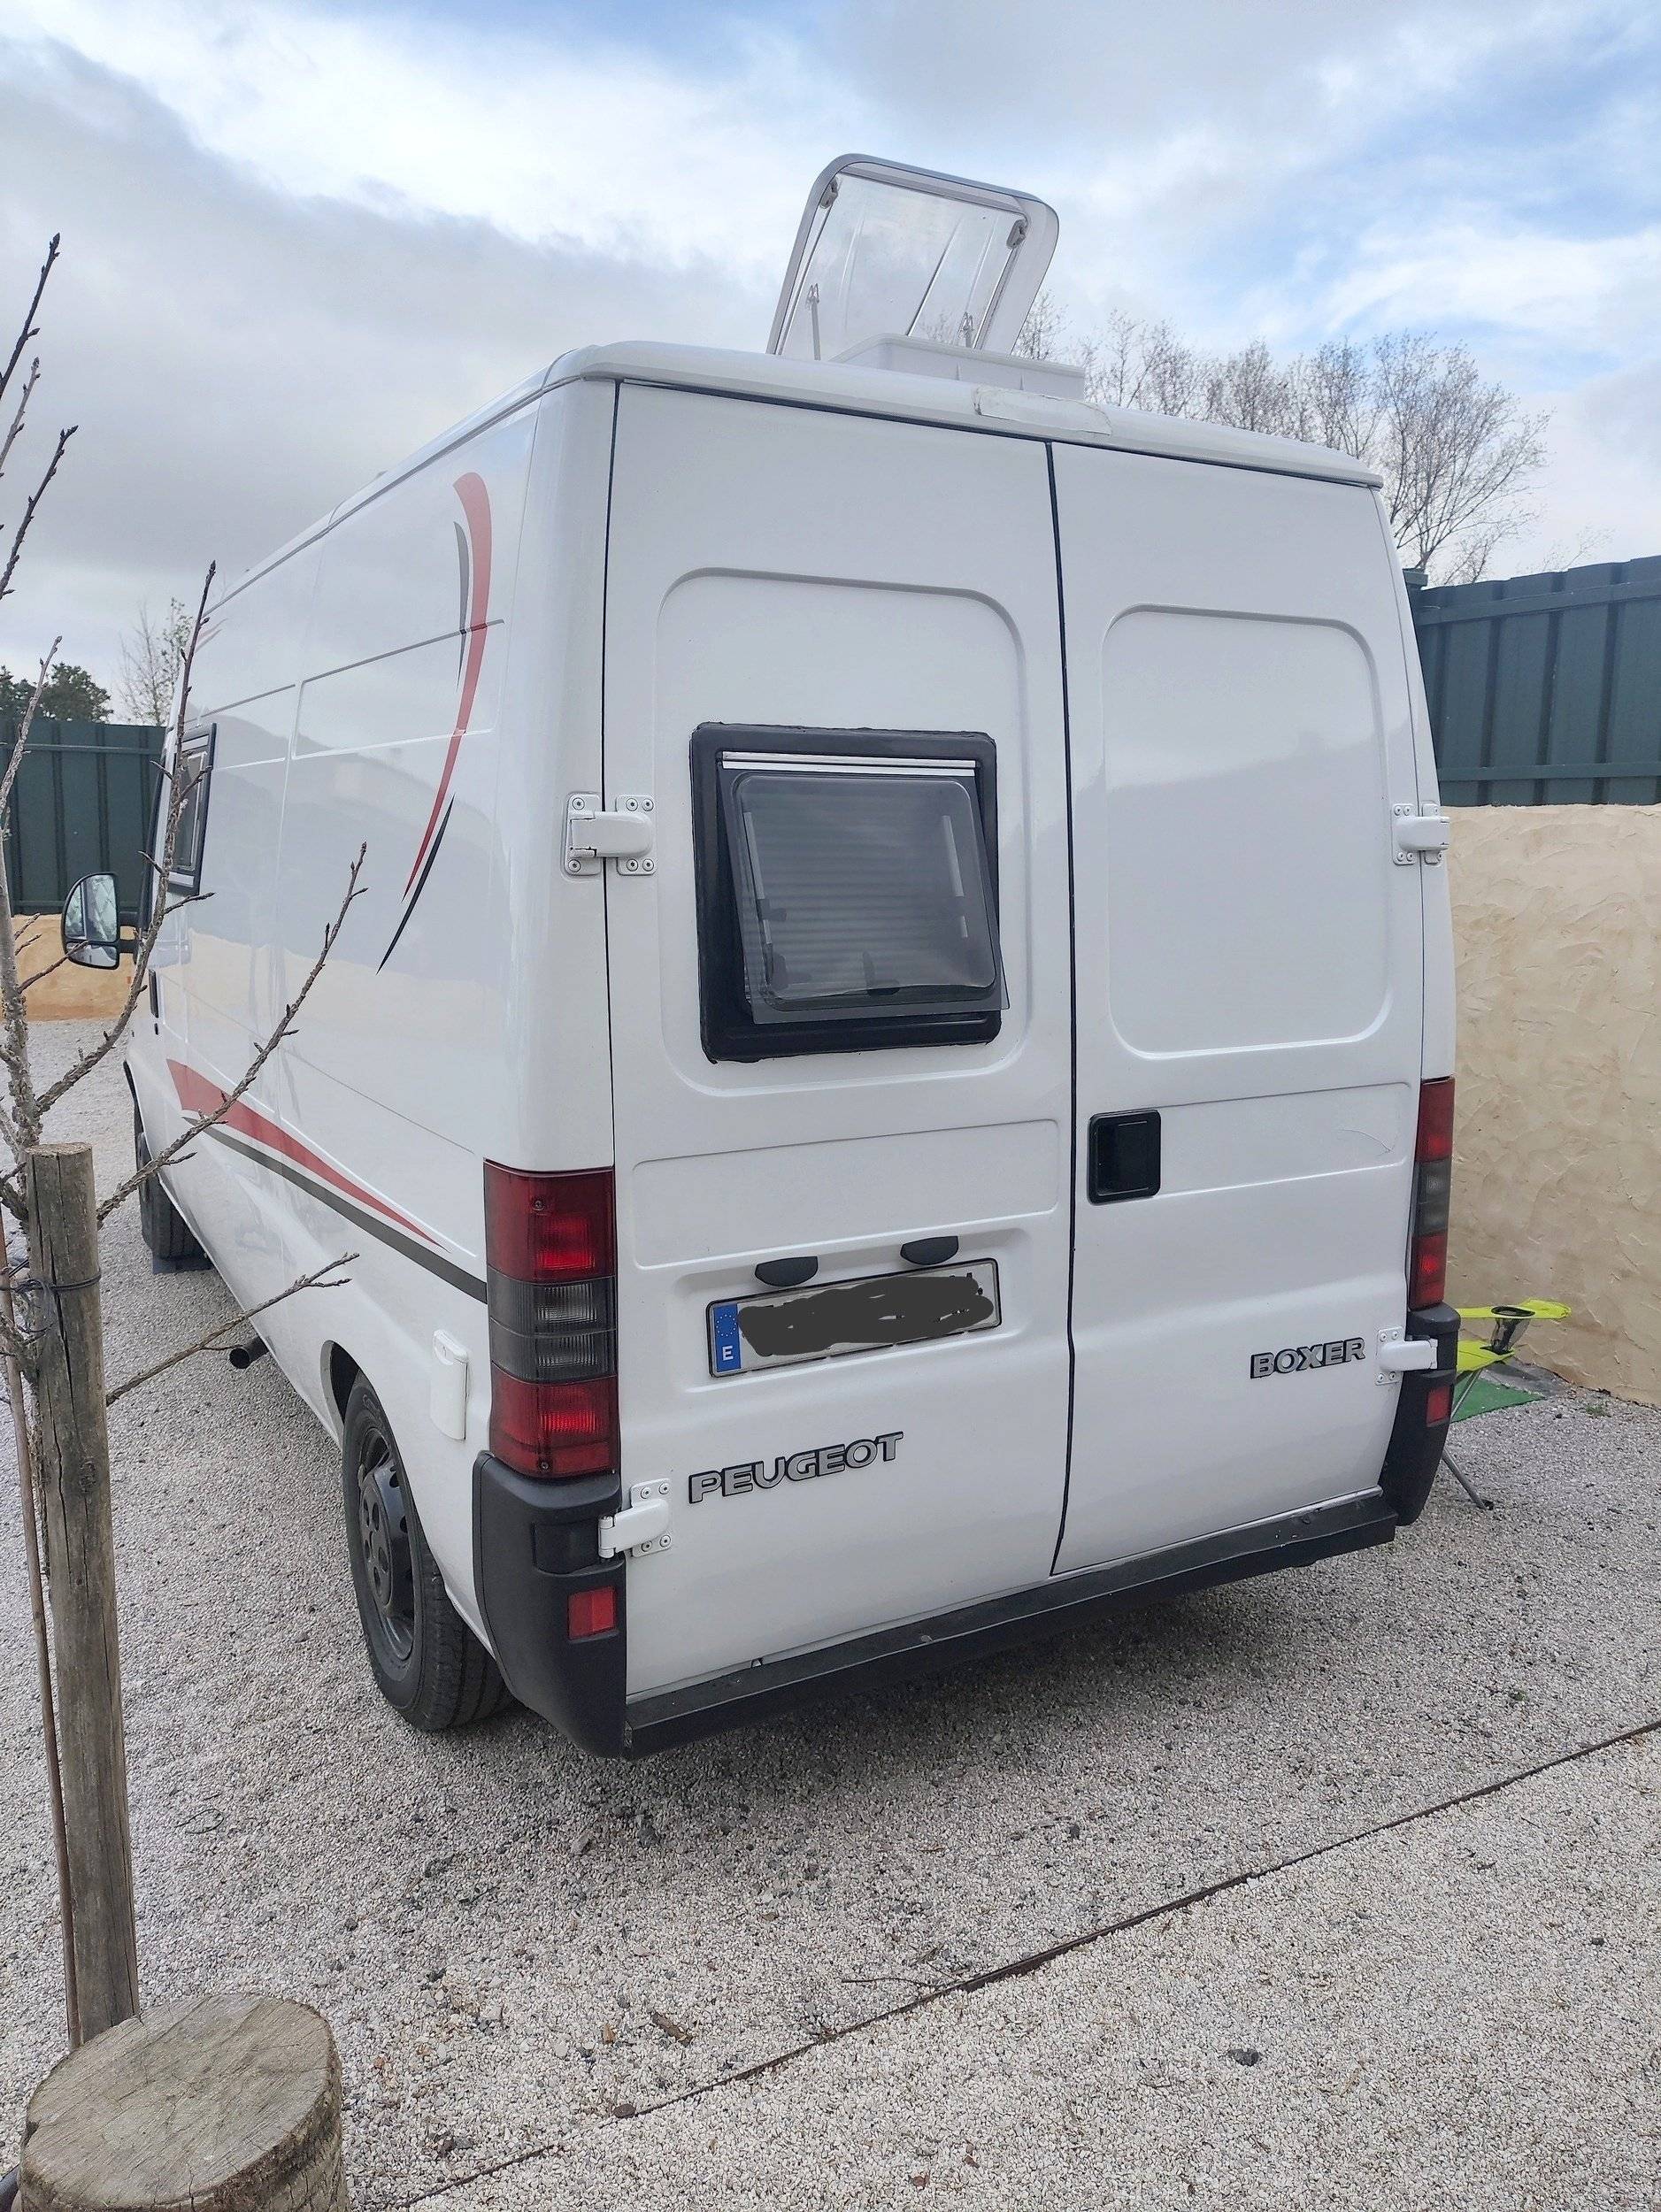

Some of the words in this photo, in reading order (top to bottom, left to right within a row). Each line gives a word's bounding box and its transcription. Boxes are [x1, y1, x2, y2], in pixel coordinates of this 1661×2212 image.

[722, 1346, 734, 1361] E
[1250, 1337, 1365, 1379] BOXER
[688, 1431, 904, 1503] PEUGEOT
